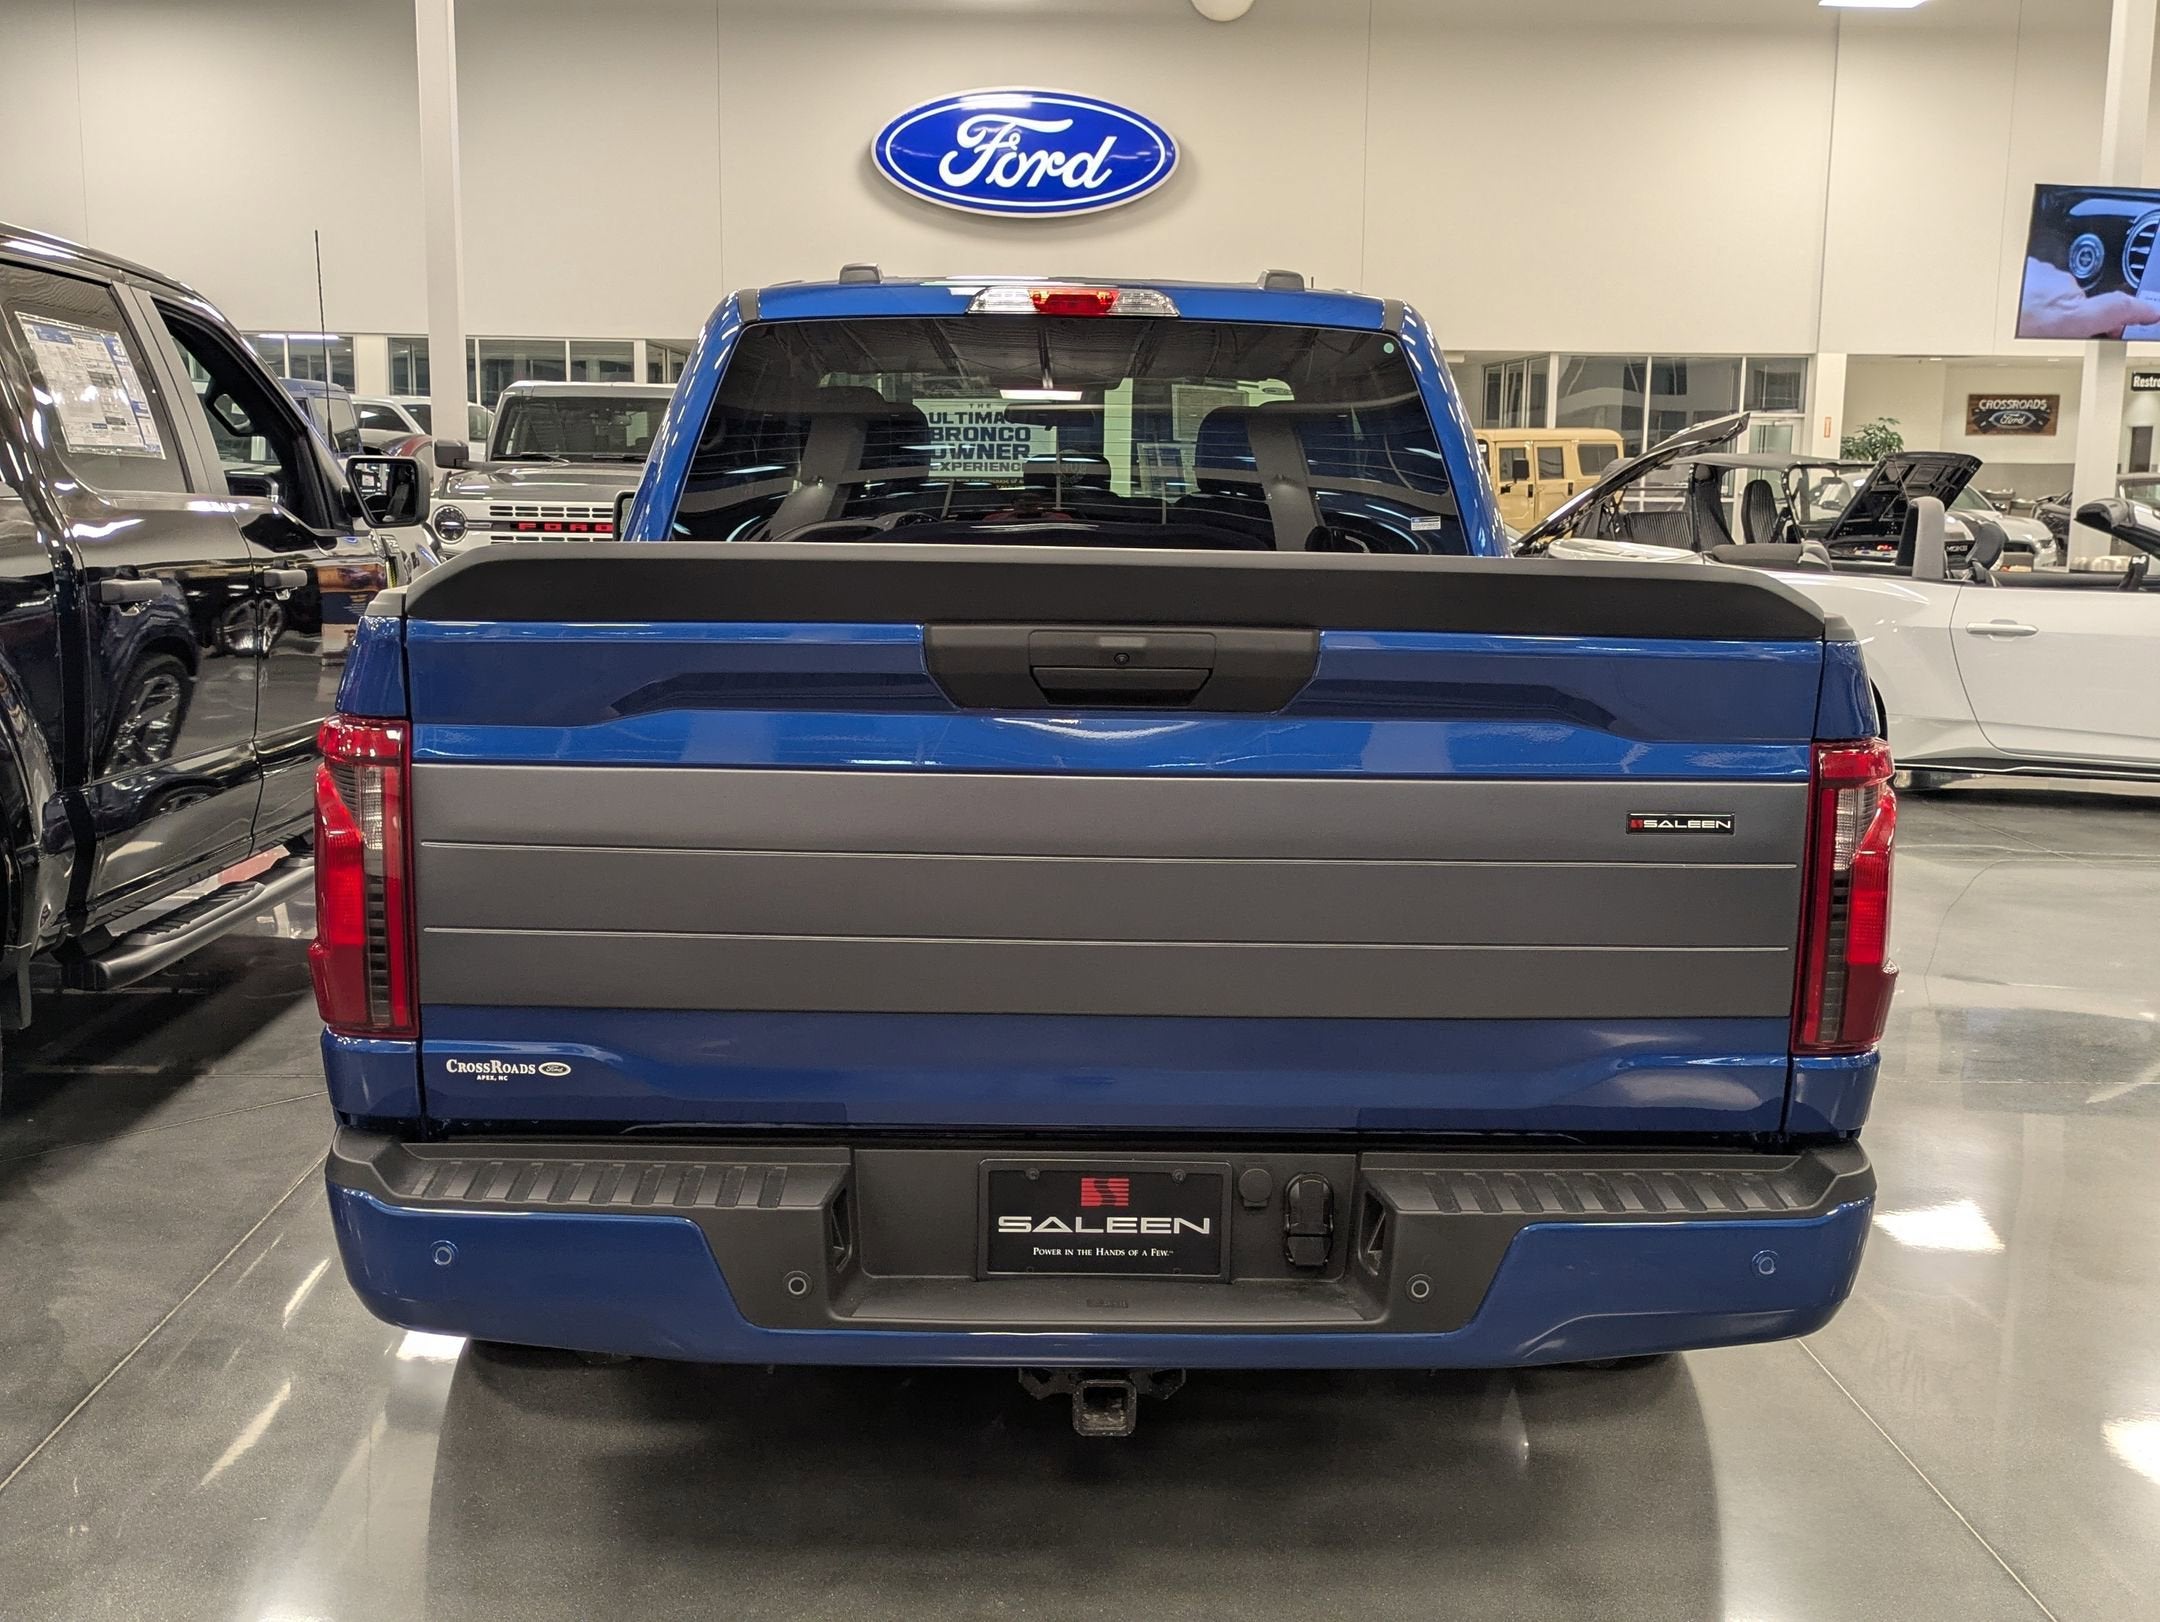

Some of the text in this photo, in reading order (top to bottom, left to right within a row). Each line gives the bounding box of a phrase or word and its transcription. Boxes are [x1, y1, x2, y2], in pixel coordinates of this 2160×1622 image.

[938, 113, 1118, 189] Ford
[1979, 399, 2048, 410] CROSSROADS
[928, 411, 1007, 425] ULTIMA
[2000, 413, 2026, 425] Ford
[930, 426, 1031, 442] BRONCO
[930, 443, 1031, 461] OWNER
[930, 462, 1024, 472] EXPERIENC
[518, 522, 614, 532] FORD
[1643, 819, 1731, 829] SALEEN
[998, 1216, 1210, 1235] SALEEN
